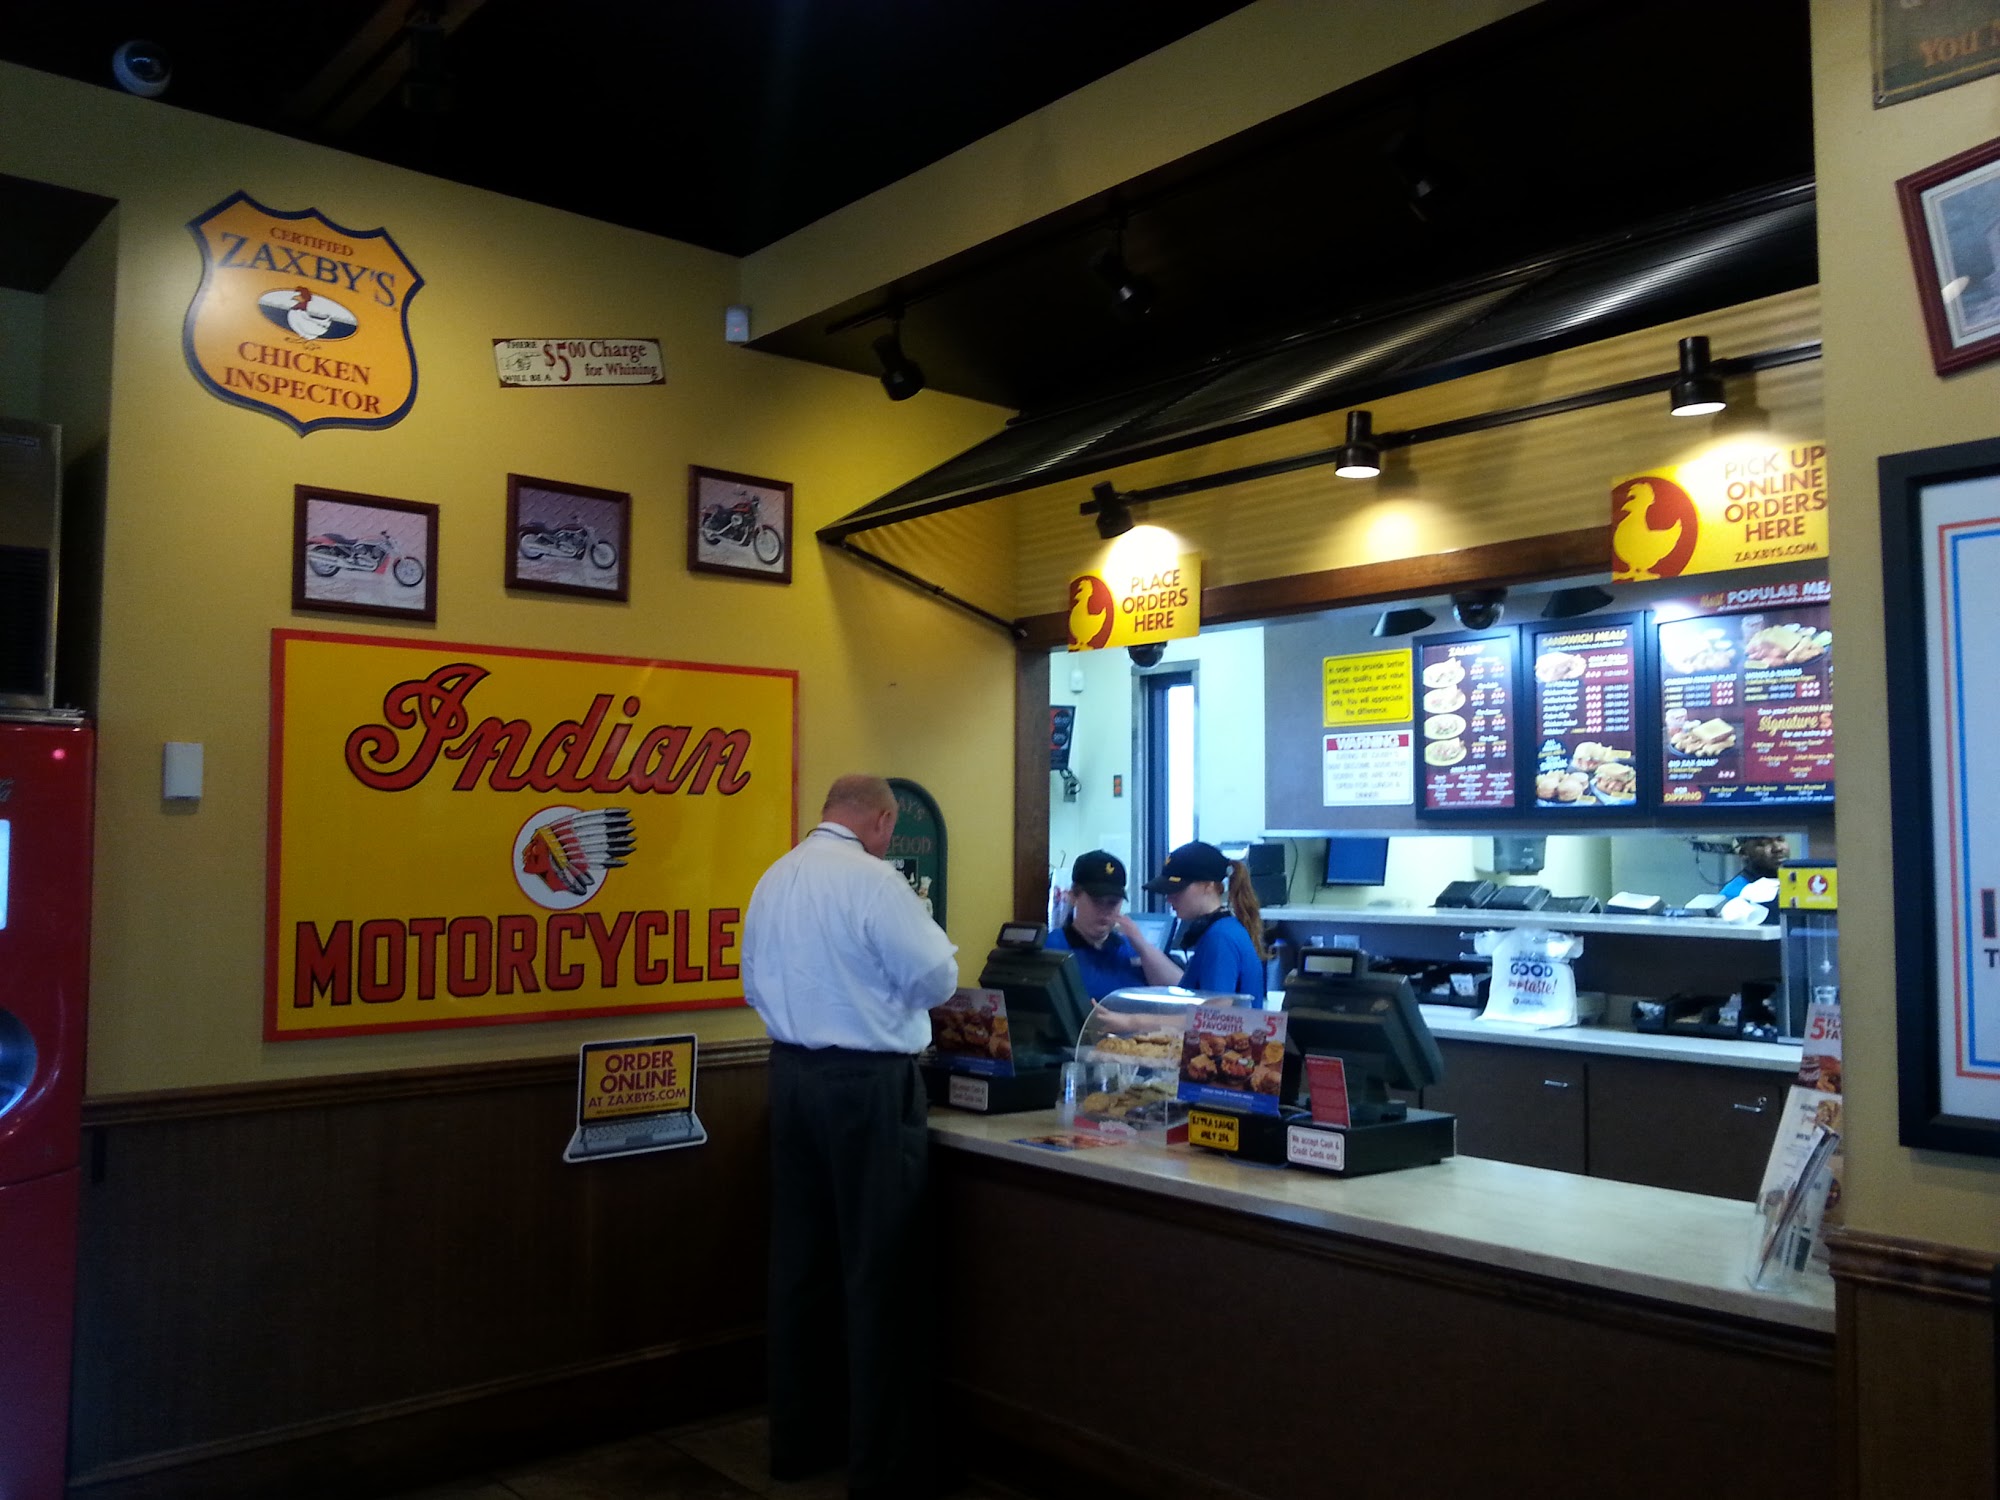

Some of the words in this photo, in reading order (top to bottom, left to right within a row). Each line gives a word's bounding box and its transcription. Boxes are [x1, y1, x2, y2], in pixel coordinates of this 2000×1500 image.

[270, 227, 354, 257] CERTIFIED
[217, 231, 397, 308] ZAXBY'S
[507, 341, 538, 349] THERE
[590, 341, 647, 364] Charge
[238, 341, 371, 386] CHICKEN
[585, 364, 601, 377] for
[606, 363, 657, 380] Whining
[223, 366, 382, 415] INSPECTOR
[1725, 452, 1780, 479] PICK
[1791, 445, 1826, 469] UP
[1727, 468, 1822, 501] ONLINE
[1725, 490, 1828, 523] ORDERS
[1746, 516, 1805, 543] HERE
[1131, 569, 1180, 593] PLACE
[1122, 588, 1188, 614] ORDERS
[1727, 582, 1799, 605] POPULAR
[1134, 610, 1174, 633] HERE
[344, 662, 752, 797] Indian
[1758, 715, 1819, 737] Signature
[1336, 734, 1399, 750] WARNING
[1511, 962, 1553, 978] GOOD
[1193, 1011, 1203, 1030] 5
[1202, 1012, 1243, 1025] FLAVORFUL
[1202, 1022, 1243, 1033] FAVORITES
[1810, 1016, 1825, 1040] 5
[605, 1050, 674, 1074] ORDER
[600, 1069, 677, 1094] ONLINE
[588, 1097, 605, 1108] AT
[607, 1087, 687, 1107] ZAXBYS.COM
[1292, 1145, 1308, 1155] Credit
[1301, 1137, 1319, 1147] accept
